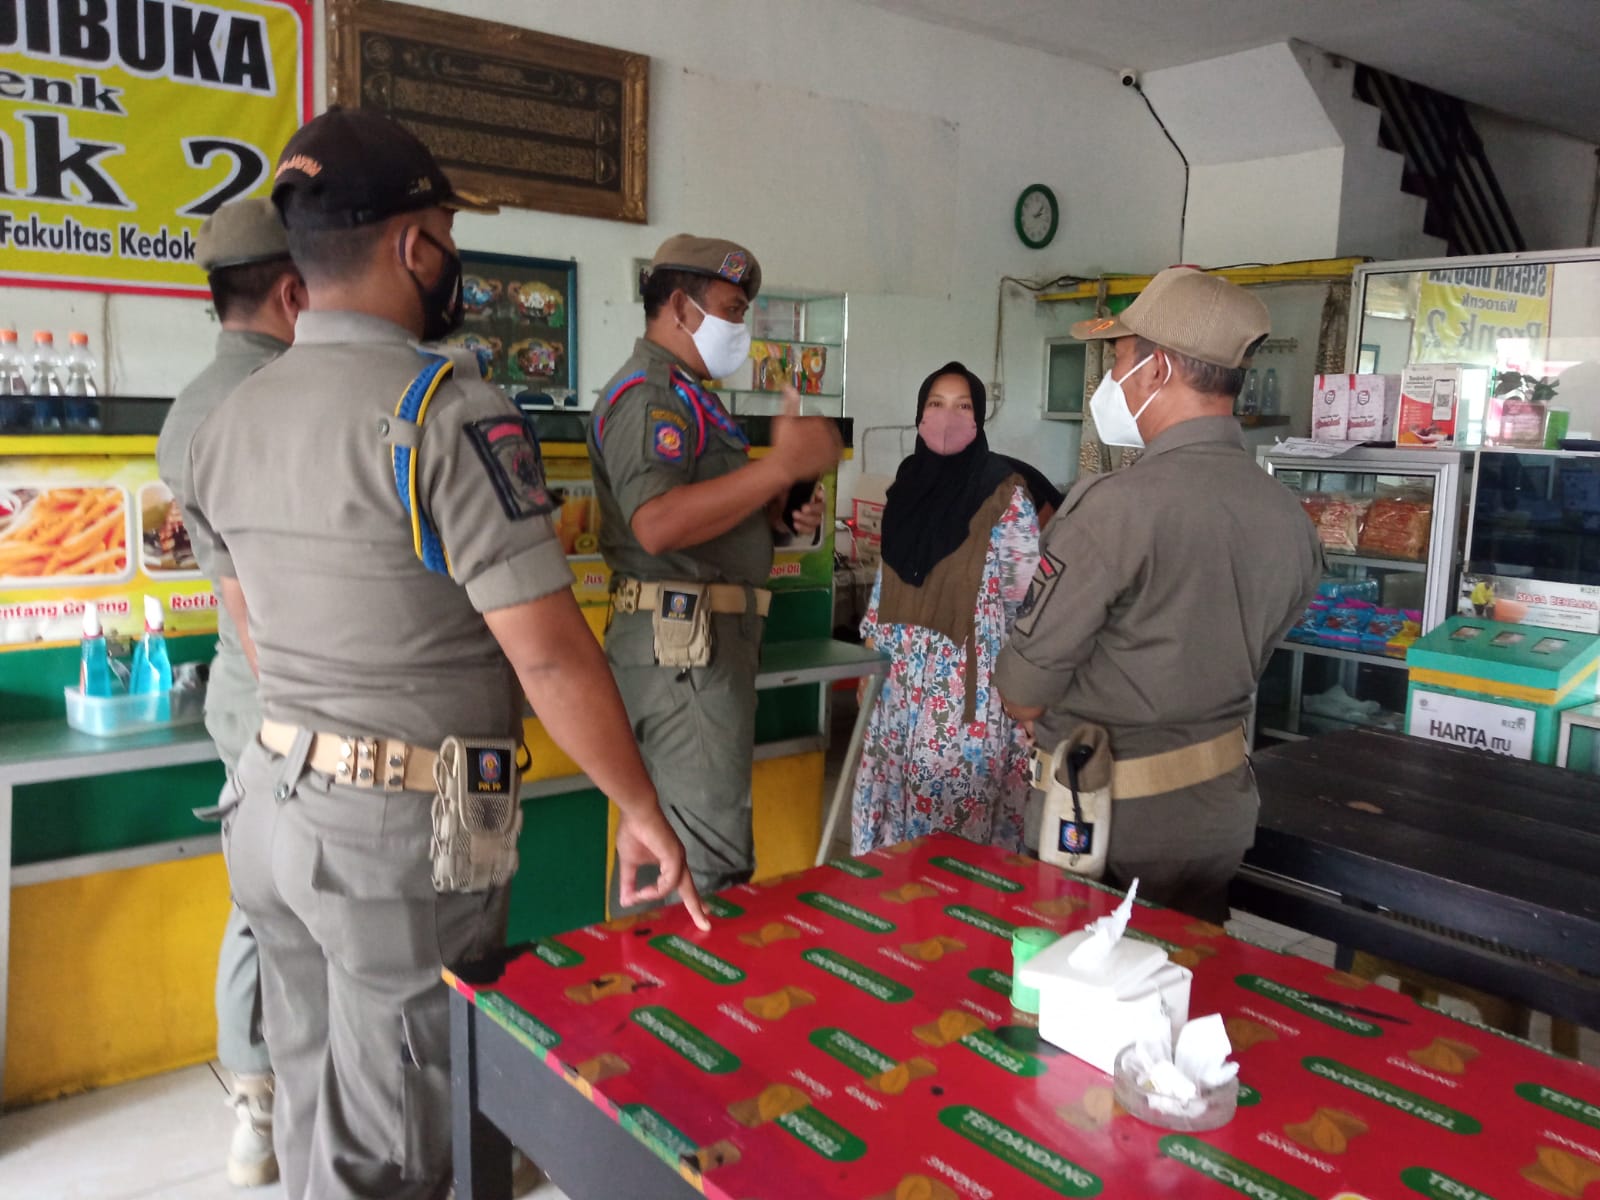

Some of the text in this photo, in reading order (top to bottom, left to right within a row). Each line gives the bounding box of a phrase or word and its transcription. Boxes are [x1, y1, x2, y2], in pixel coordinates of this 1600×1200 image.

[184, 140, 264, 215] 2
[0, 215, 111, 252] Fakultas
[172, 595, 205, 610] Roti
[1429, 719, 1487, 747] HARTA
[1490, 736, 1511, 752] ITU
[1310, 1062, 1456, 1130] DANDANG TEH
[1540, 1087, 1583, 1110] TEH
[994, 1125, 1093, 1188] DANDANG
